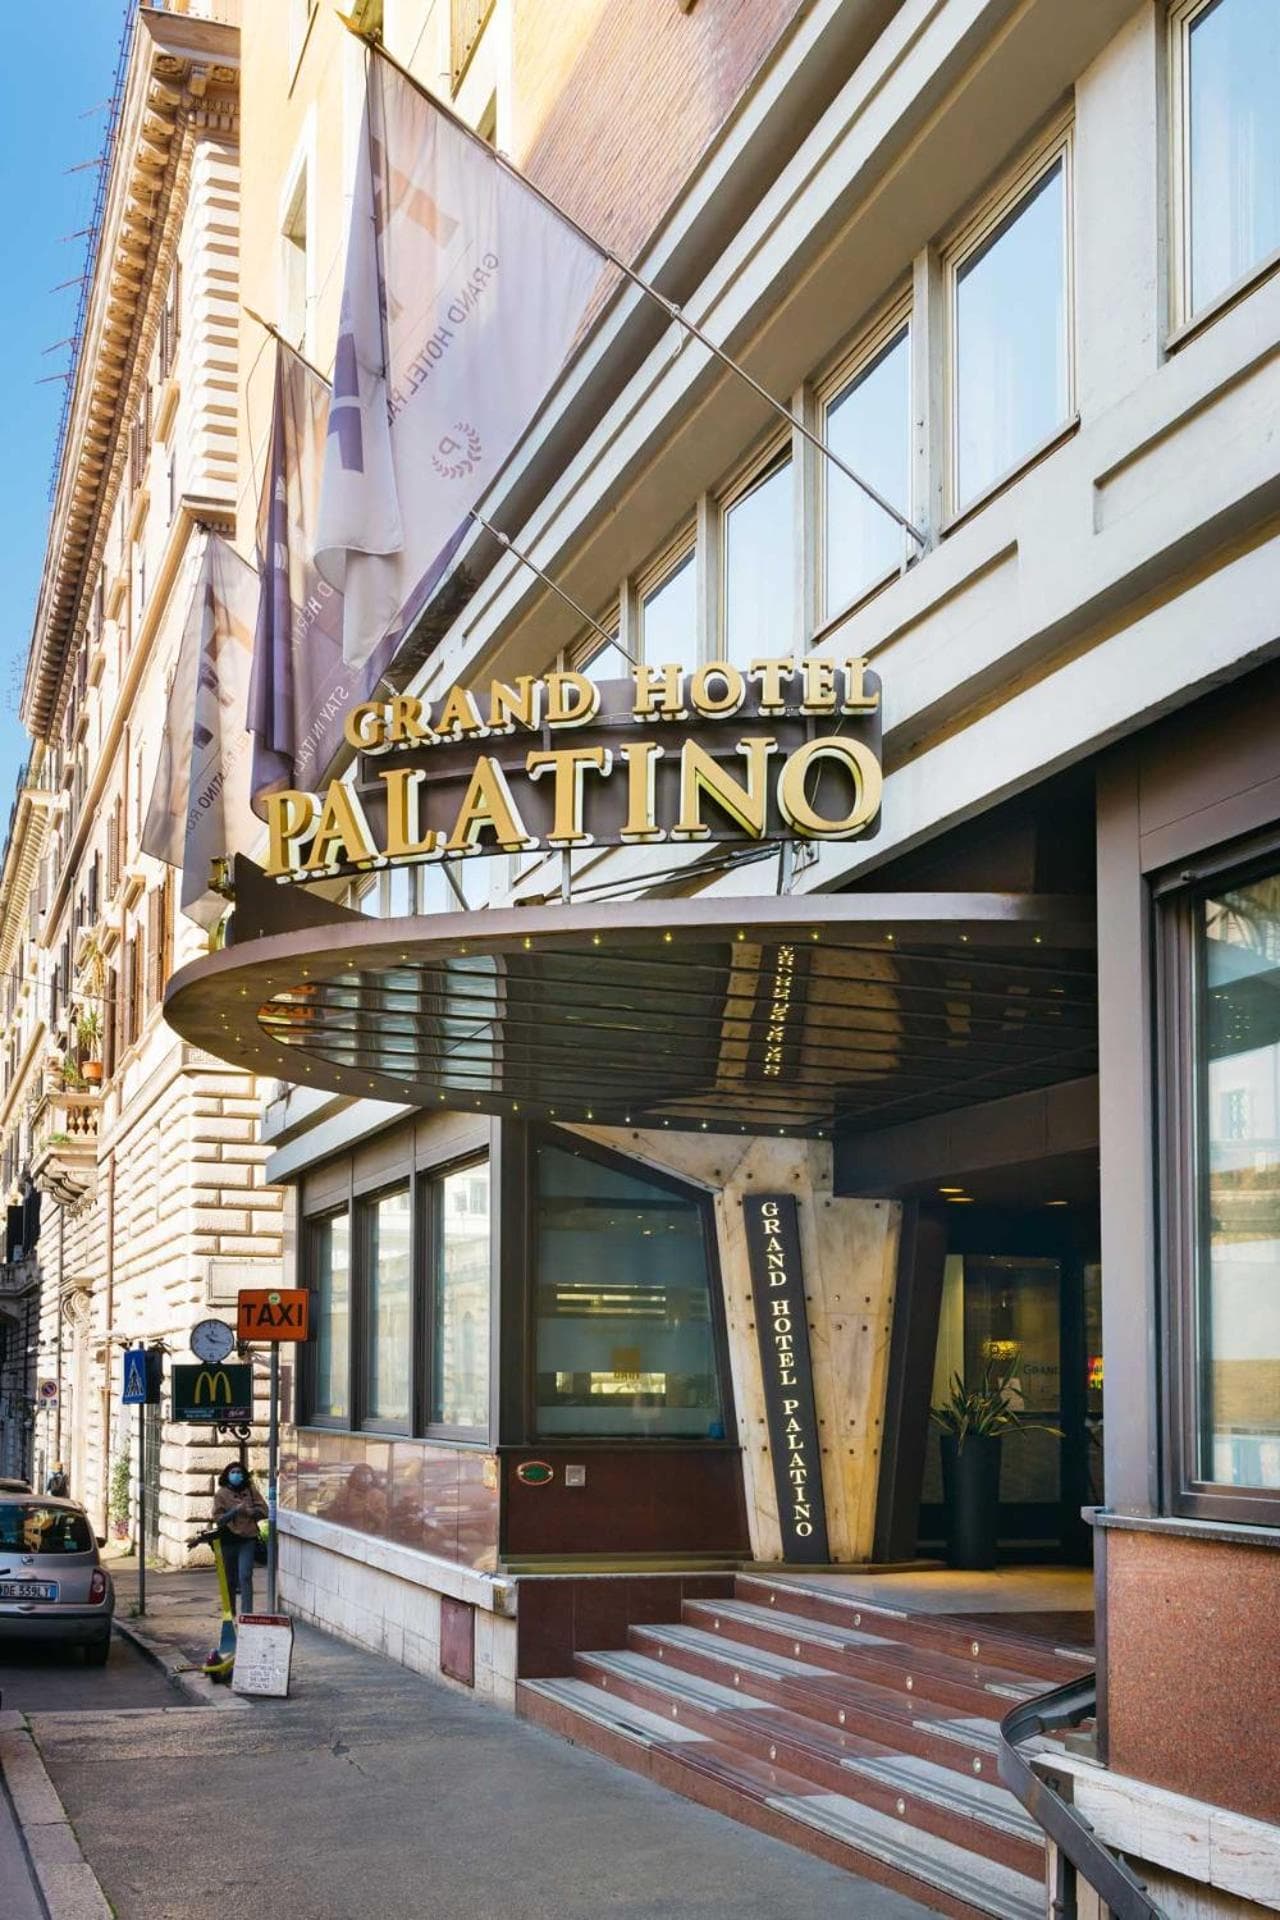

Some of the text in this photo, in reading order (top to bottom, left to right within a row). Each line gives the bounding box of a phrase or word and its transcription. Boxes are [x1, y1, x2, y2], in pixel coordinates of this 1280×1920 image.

[343, 657, 880, 754] GRAND HOTEL
[262, 735, 882, 884] PALATINO
[241, 1303, 303, 1327] TAXI
[761, 1201, 813, 1537] GRAND HOTEL PALATINO
